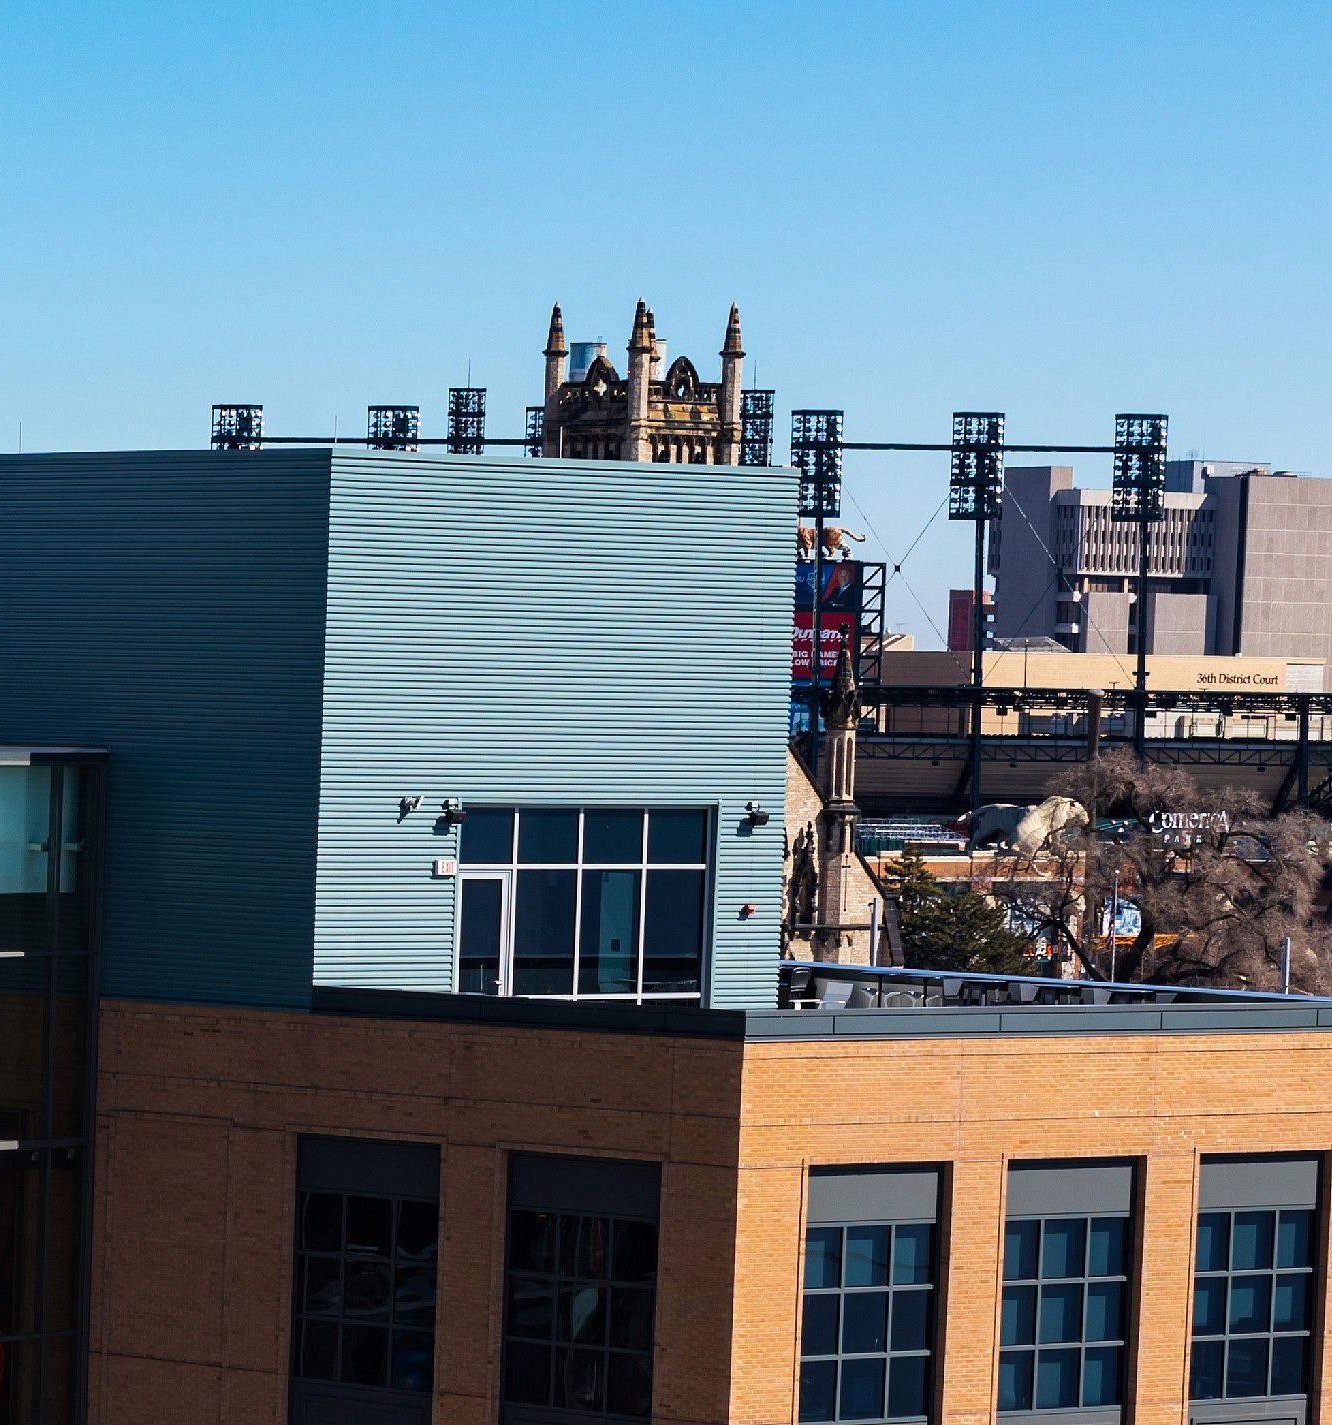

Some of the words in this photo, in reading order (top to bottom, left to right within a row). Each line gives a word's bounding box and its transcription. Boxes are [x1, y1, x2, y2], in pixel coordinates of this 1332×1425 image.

[1196, 672, 1216, 684] 36th
[1219, 673, 1251, 685] District
[1253, 674, 1279, 685] Court
